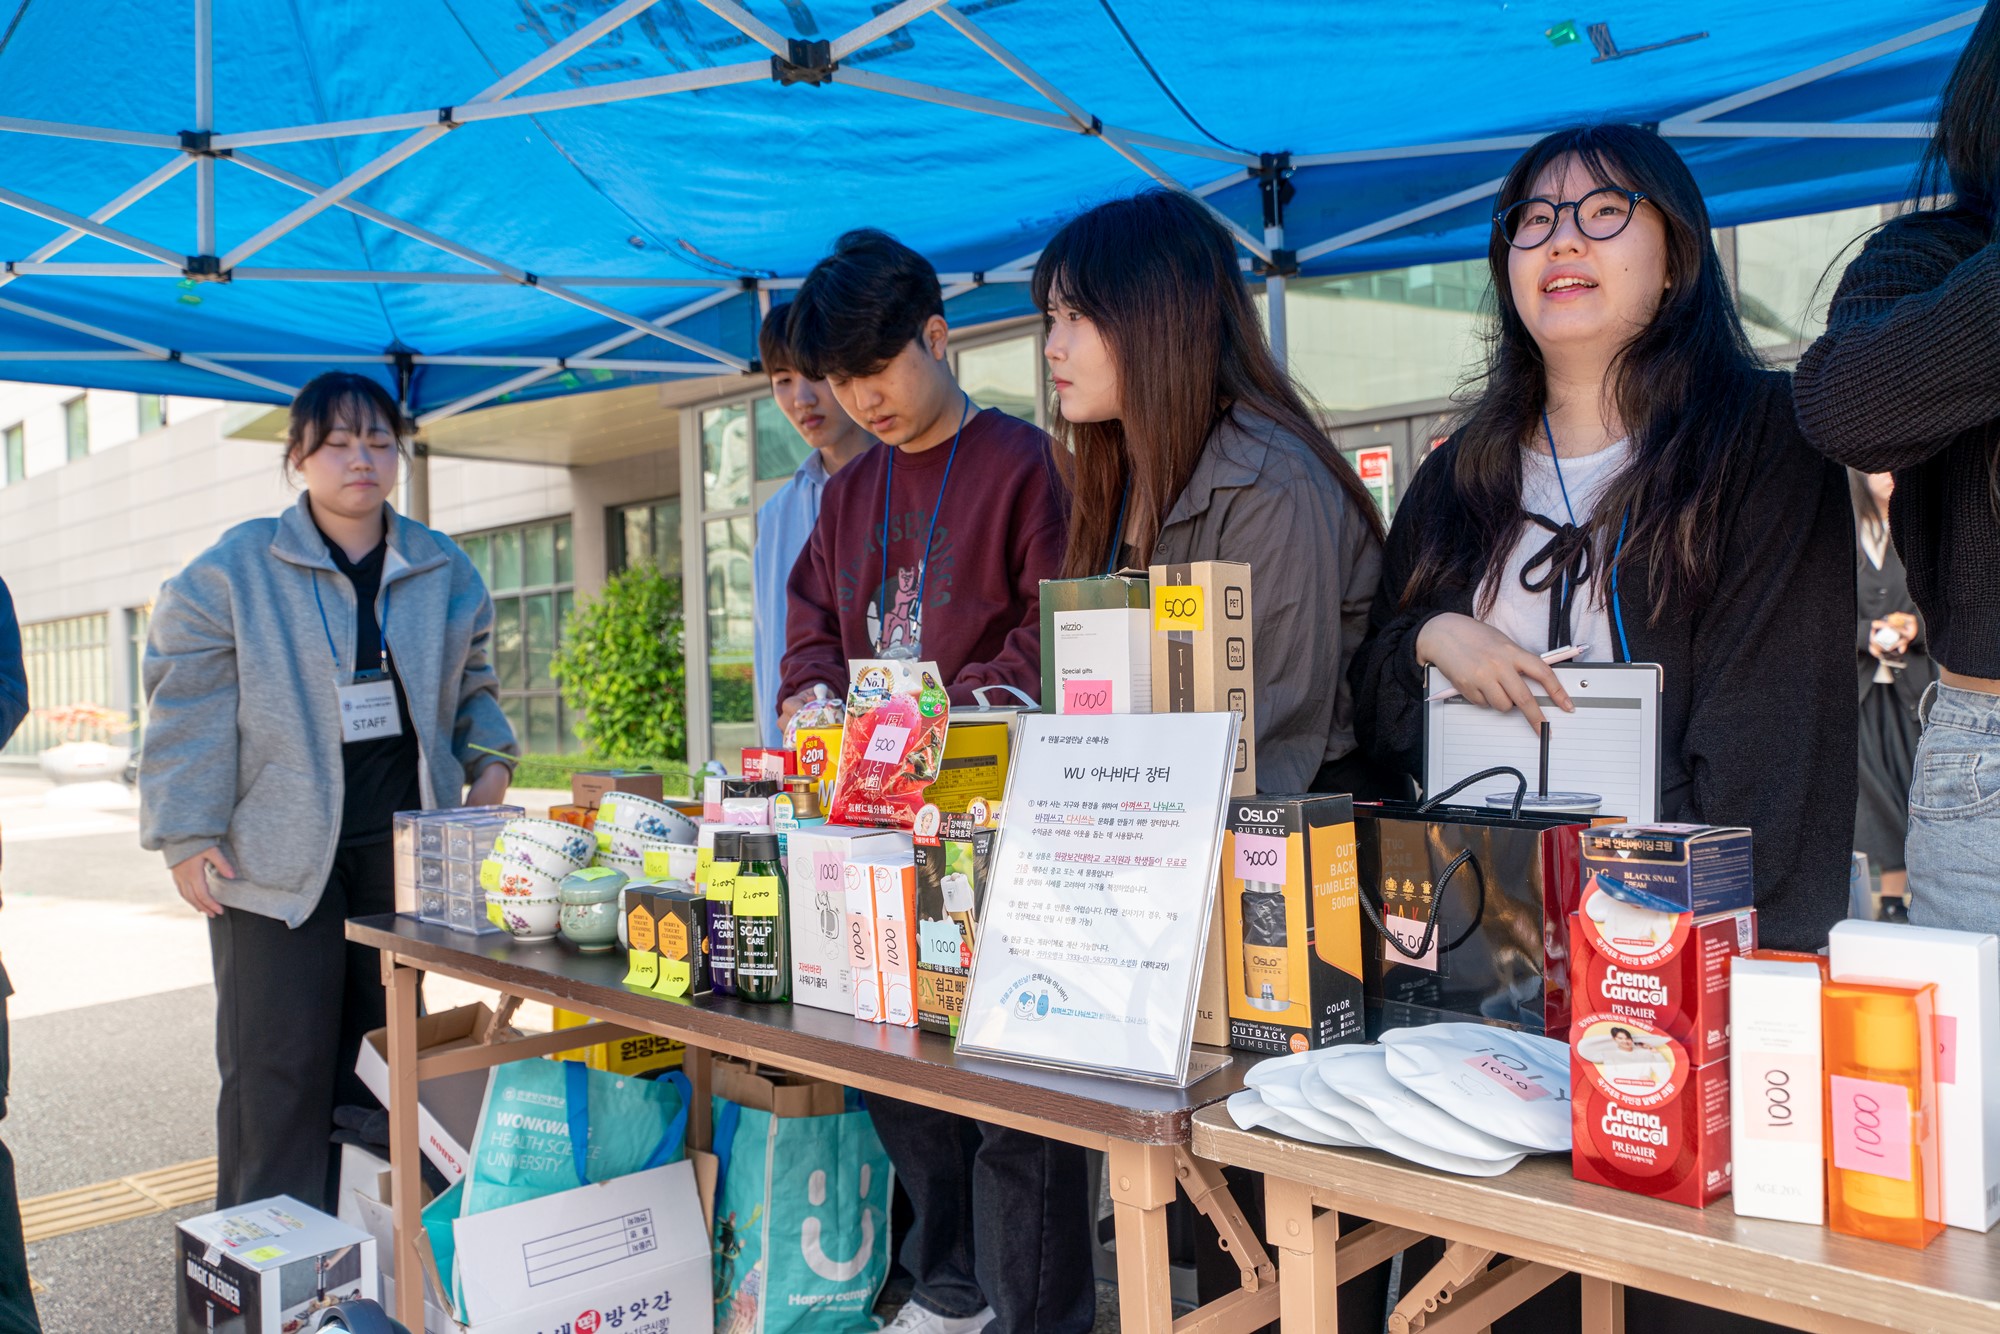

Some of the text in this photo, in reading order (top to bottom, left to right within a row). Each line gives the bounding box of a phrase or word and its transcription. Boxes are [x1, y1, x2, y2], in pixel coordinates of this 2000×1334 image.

[1164, 597, 1196, 618] 500
[1229, 599, 1240, 608] PET
[1231, 645, 1241, 654] Only
[1230, 655, 1243, 663] COLD
[864, 677, 885, 687] No.1
[1073, 690, 1107, 708] 1000
[353, 716, 388, 731] STAFF
[874, 738, 896, 752] 500
[1048, 736, 1110, 744] 원불교열린날 은혜나눔
[801, 749, 824, 763] +20개
[1064, 766, 1171, 783] WU 아나바다 장터
[973, 805, 985, 820] 1위
[1036, 800, 1048, 808] 내가
[1049, 801, 1061, 809] 사는
[1063, 801, 1080, 809] 지구와
[1081, 801, 1099, 810] 환경을
[1101, 802, 1118, 811] 위하여
[950, 820, 973, 829] 강력해진
[1066, 814, 1096, 825] 다시쓰는
[1098, 817, 1114, 826] 문화를
[1117, 818, 1134, 826] 만들기
[1136, 818, 1148, 827] 위한
[1150, 819, 1180, 828] 장터입니다.
[1031, 828, 1144, 841] 수익금은 어려운 이웃을 돕는 사용됩니다.
[1238, 827, 1286, 835] OUTBACK
[1336, 843, 1354, 858] OUT
[1612, 838, 1654, 851] 안티에이징
[1655, 841, 1673, 853] 크림
[1035, 851, 1187, 867] 상품은 원광보건대학교 교직원과 학생들이 무료로
[1243, 849, 1278, 866] 3000
[819, 863, 839, 881] 1000
[1050, 867, 1062, 876] 중고
[1085, 869, 1114, 878] 물품입니다.
[1330, 860, 1355, 876] BACK
[711, 878, 735, 888] 2,000
[1624, 871, 1677, 883] BLACK SNAIL
[1063, 881, 1086, 890] 고려하여
[1088, 882, 1105, 892] 가격을
[1314, 877, 1357, 897] TUMBLER
[1624, 881, 1648, 889] CREAM
[742, 890, 770, 900] 2,000
[1331, 893, 1357, 912] 500ml
[1073, 904, 1103, 915] 어렵습니다.
[1104, 908, 1118, 917] (다만
[1121, 909, 1145, 918] 전자기기
[1166, 912, 1179, 921] 작동
[713, 919, 734, 930] AGIN
[1078, 917, 1093, 927] 가능)
[662, 933, 683, 941] CLEANSING
[664, 927, 680, 935] YOGURT
[740, 925, 772, 937] SCALP
[746, 938, 765, 946] CARE
[852, 922, 866, 961] 1000
[885, 928, 900, 966] 1000
[930, 939, 956, 954] 1000
[635, 964, 653, 974] 1,000
[1140, 960, 1170, 971] (대학교당)
[666, 973, 684, 984] 1,000
[798, 975, 828, 988] 샤워기홀더
[1031, 973, 1052, 985] 은혜나눔
[1606, 965, 1661, 990] Crema
[918, 975, 935, 1000] 3N
[935, 977, 968, 995] 쉽고 빠
[1601, 979, 1669, 1006] Caracol
[1326, 999, 1350, 1014] COLOR
[1612, 1004, 1657, 1020] PREMIER
[1344, 1011, 1355, 1019] GREEN
[1344, 1019, 1355, 1028] BLACK
[1232, 1026, 1286, 1041] OUTBACK
[621, 1035, 686, 1062] 원광보
[1232, 1038, 1288, 1053] TUMBLER
[1482, 1061, 1528, 1090] 1000
[1764, 1069, 1793, 1127] 1000
[1607, 1101, 1661, 1129] Crema
[1601, 1115, 1668, 1147] Caracol
[1853, 1093, 1884, 1158] 1000
[490, 1130, 544, 1151] HEALTH
[429, 1135, 462, 1175] Canon
[1612, 1140, 1657, 1160] PREMIER
[487, 1150, 565, 1173] UNIVERSITY
[1755, 1182, 1778, 1196] AGE
[788, 1294, 834, 1307] Happy
[604, 1290, 672, 1329] 방앗간
